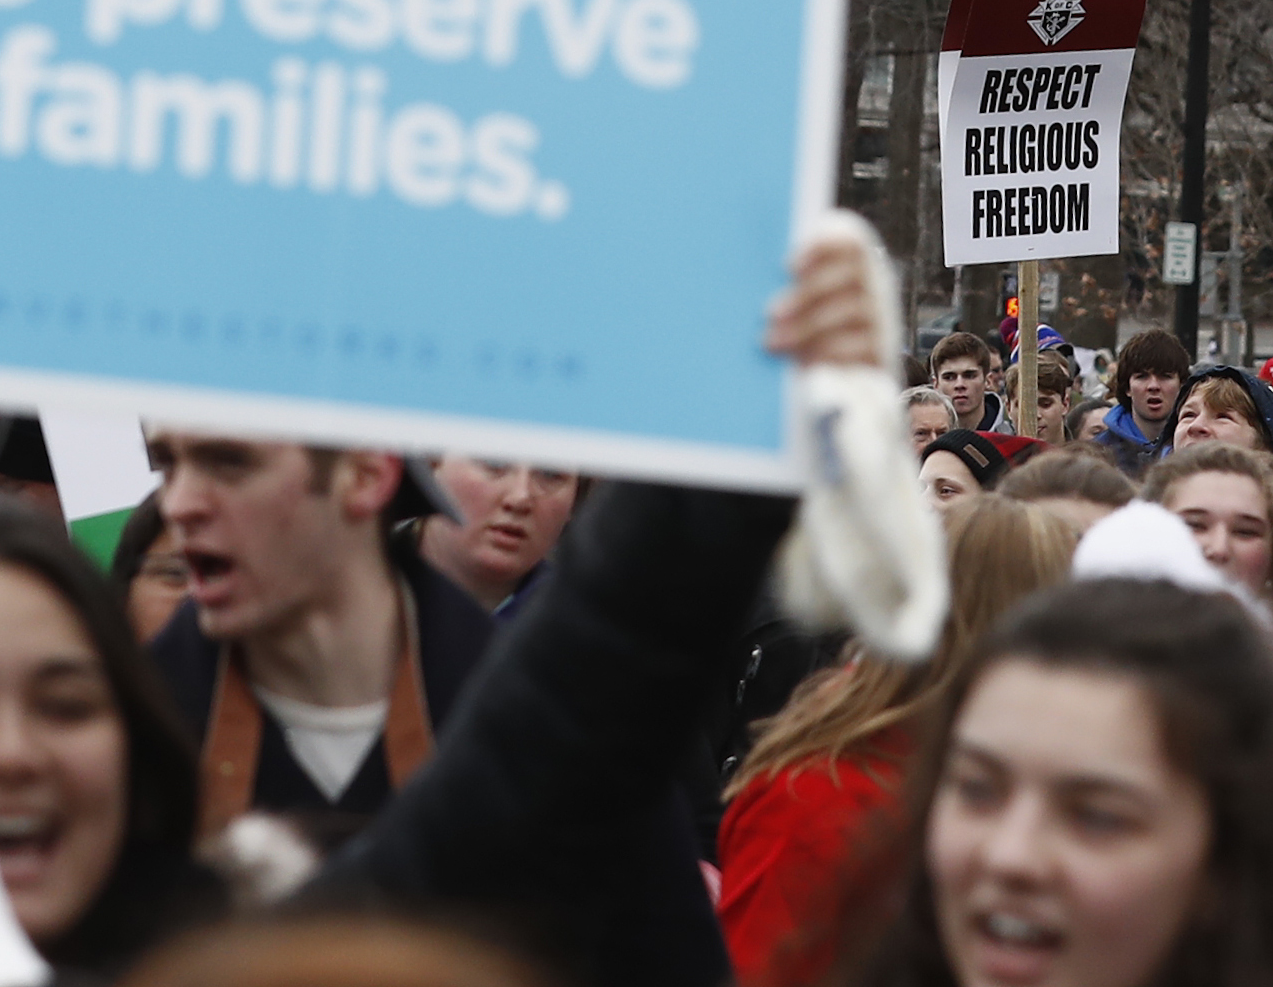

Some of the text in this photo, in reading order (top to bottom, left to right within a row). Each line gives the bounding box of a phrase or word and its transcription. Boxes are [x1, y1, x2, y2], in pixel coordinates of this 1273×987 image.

[978, 64, 1102, 114] RESPECT
[964, 120, 1100, 177] RELIGIOUS
[972, 183, 1090, 239] FREEDOM
